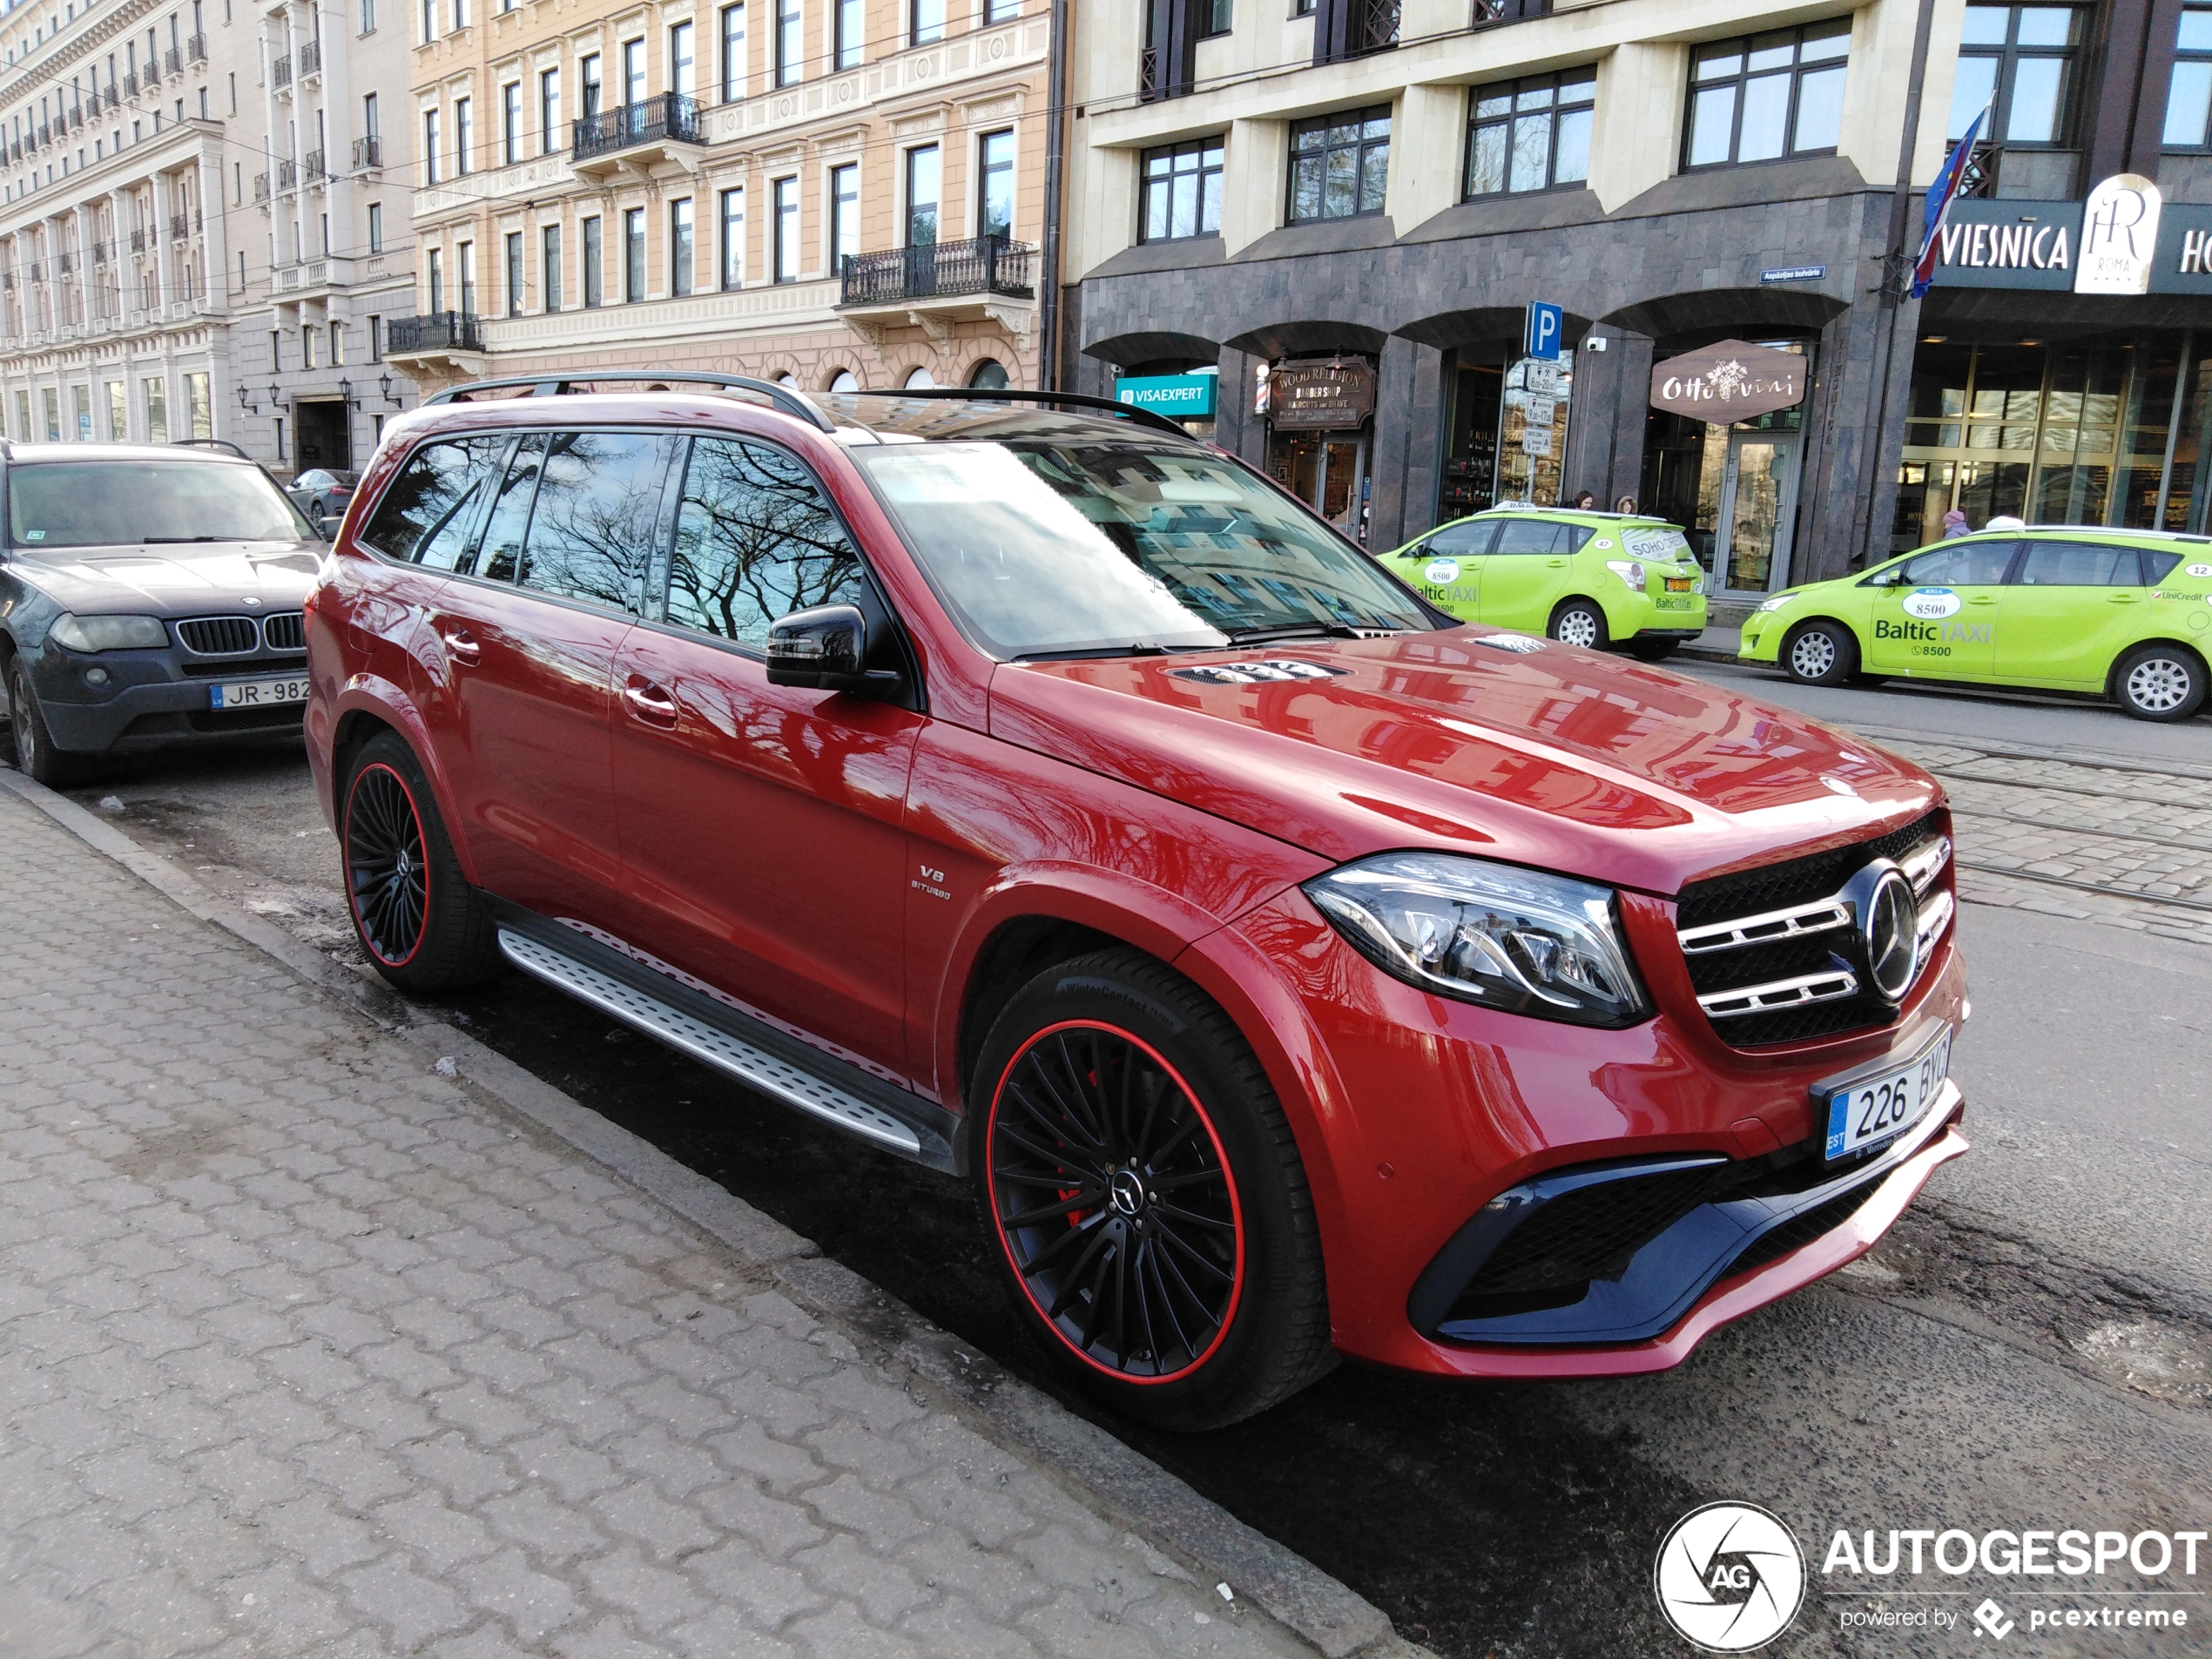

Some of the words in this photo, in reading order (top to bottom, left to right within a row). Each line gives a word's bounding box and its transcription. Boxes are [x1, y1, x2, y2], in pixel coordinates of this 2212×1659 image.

[1941, 217, 2068, 269] VIESNĪCA
[2098, 257, 2130, 272] ROMA
[1764, 271, 1794, 280] Aspāzijas
[1538, 309, 1555, 351] P
[1279, 372, 1311, 389] WOOD
[1312, 368, 1361, 388] RELIGION
[1136, 387, 1204, 402] VISAEXPERT
[1296, 387, 1322, 399] BARBER
[1323, 386, 1341, 398] SHOP
[1662, 376, 1714, 401] Otto
[1328, 400, 1348, 408] SHAVE
[1543, 438, 1548, 447] A
[1432, 571, 1451, 581] 8500
[2162, 592, 2202, 601] UniCredit
[1916, 604, 1946, 615] 8500
[1923, 646, 1951, 657] 8500
[920, 865, 944, 883] V8
[911, 880, 951, 900] BITURBO
[1855, 1076, 1907, 1139] 226
[1919, 1040, 1946, 1107] BYC
[1827, 1131, 1844, 1150] EST
